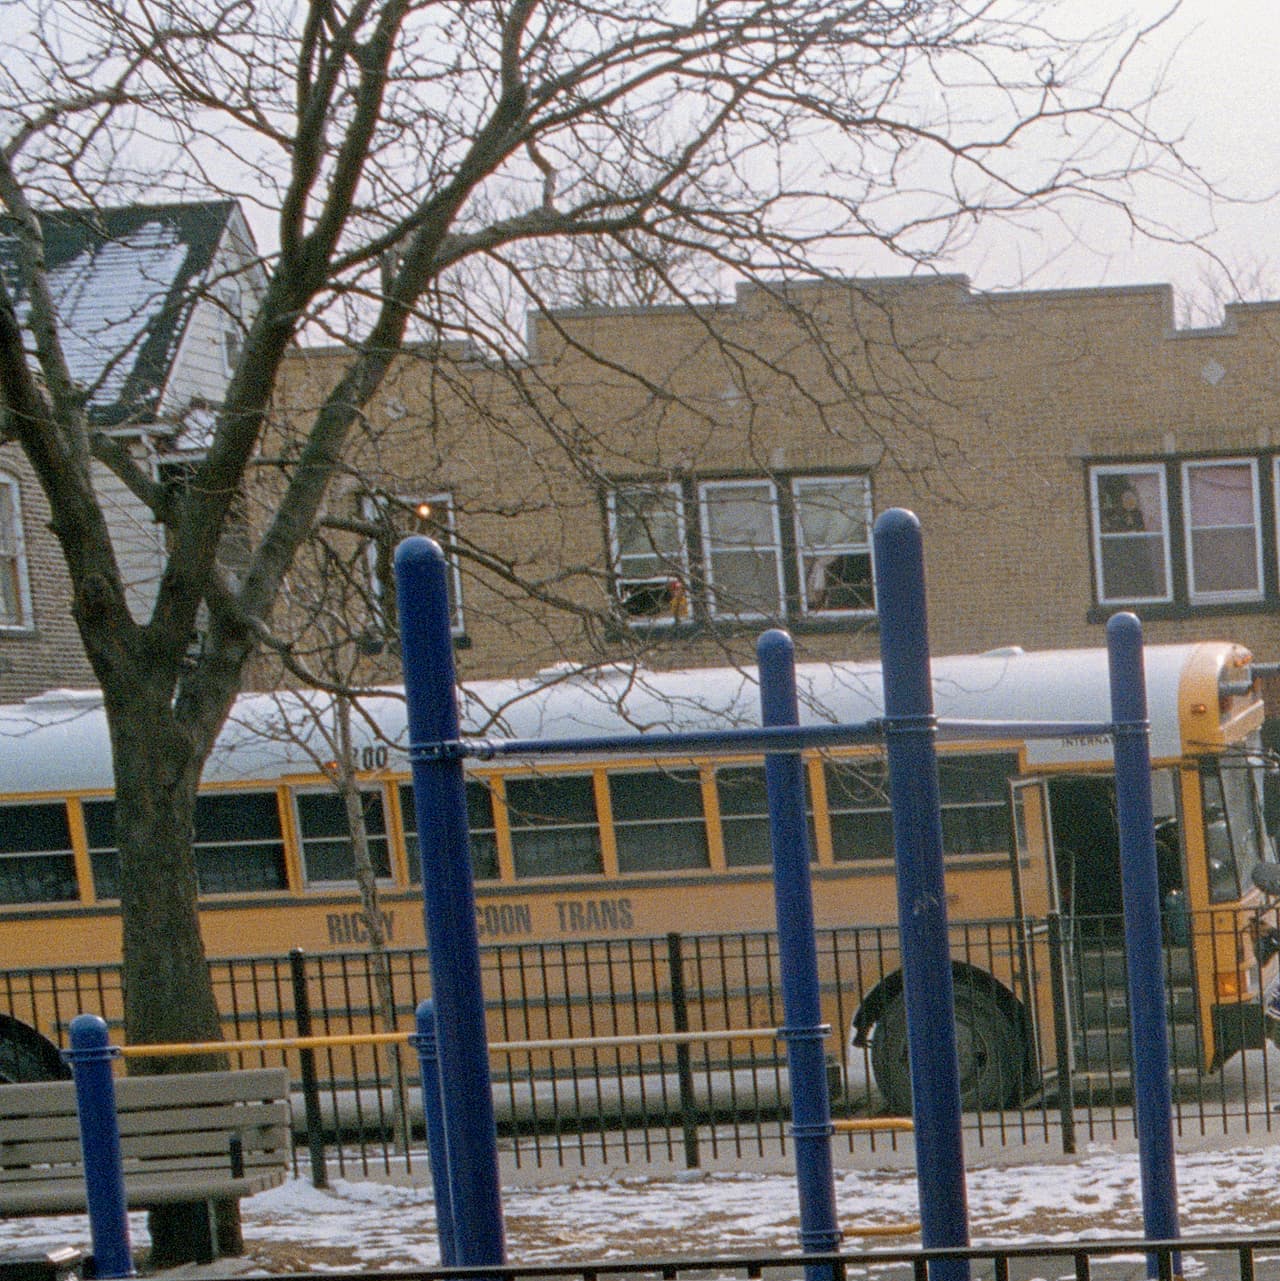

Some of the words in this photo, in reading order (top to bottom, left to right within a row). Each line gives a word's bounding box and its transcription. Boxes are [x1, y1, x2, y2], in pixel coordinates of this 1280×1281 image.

[1061, 733, 1114, 748] INTERNA
[326, 910, 394, 944] RICY
[555, 898, 634, 932] TRANS
